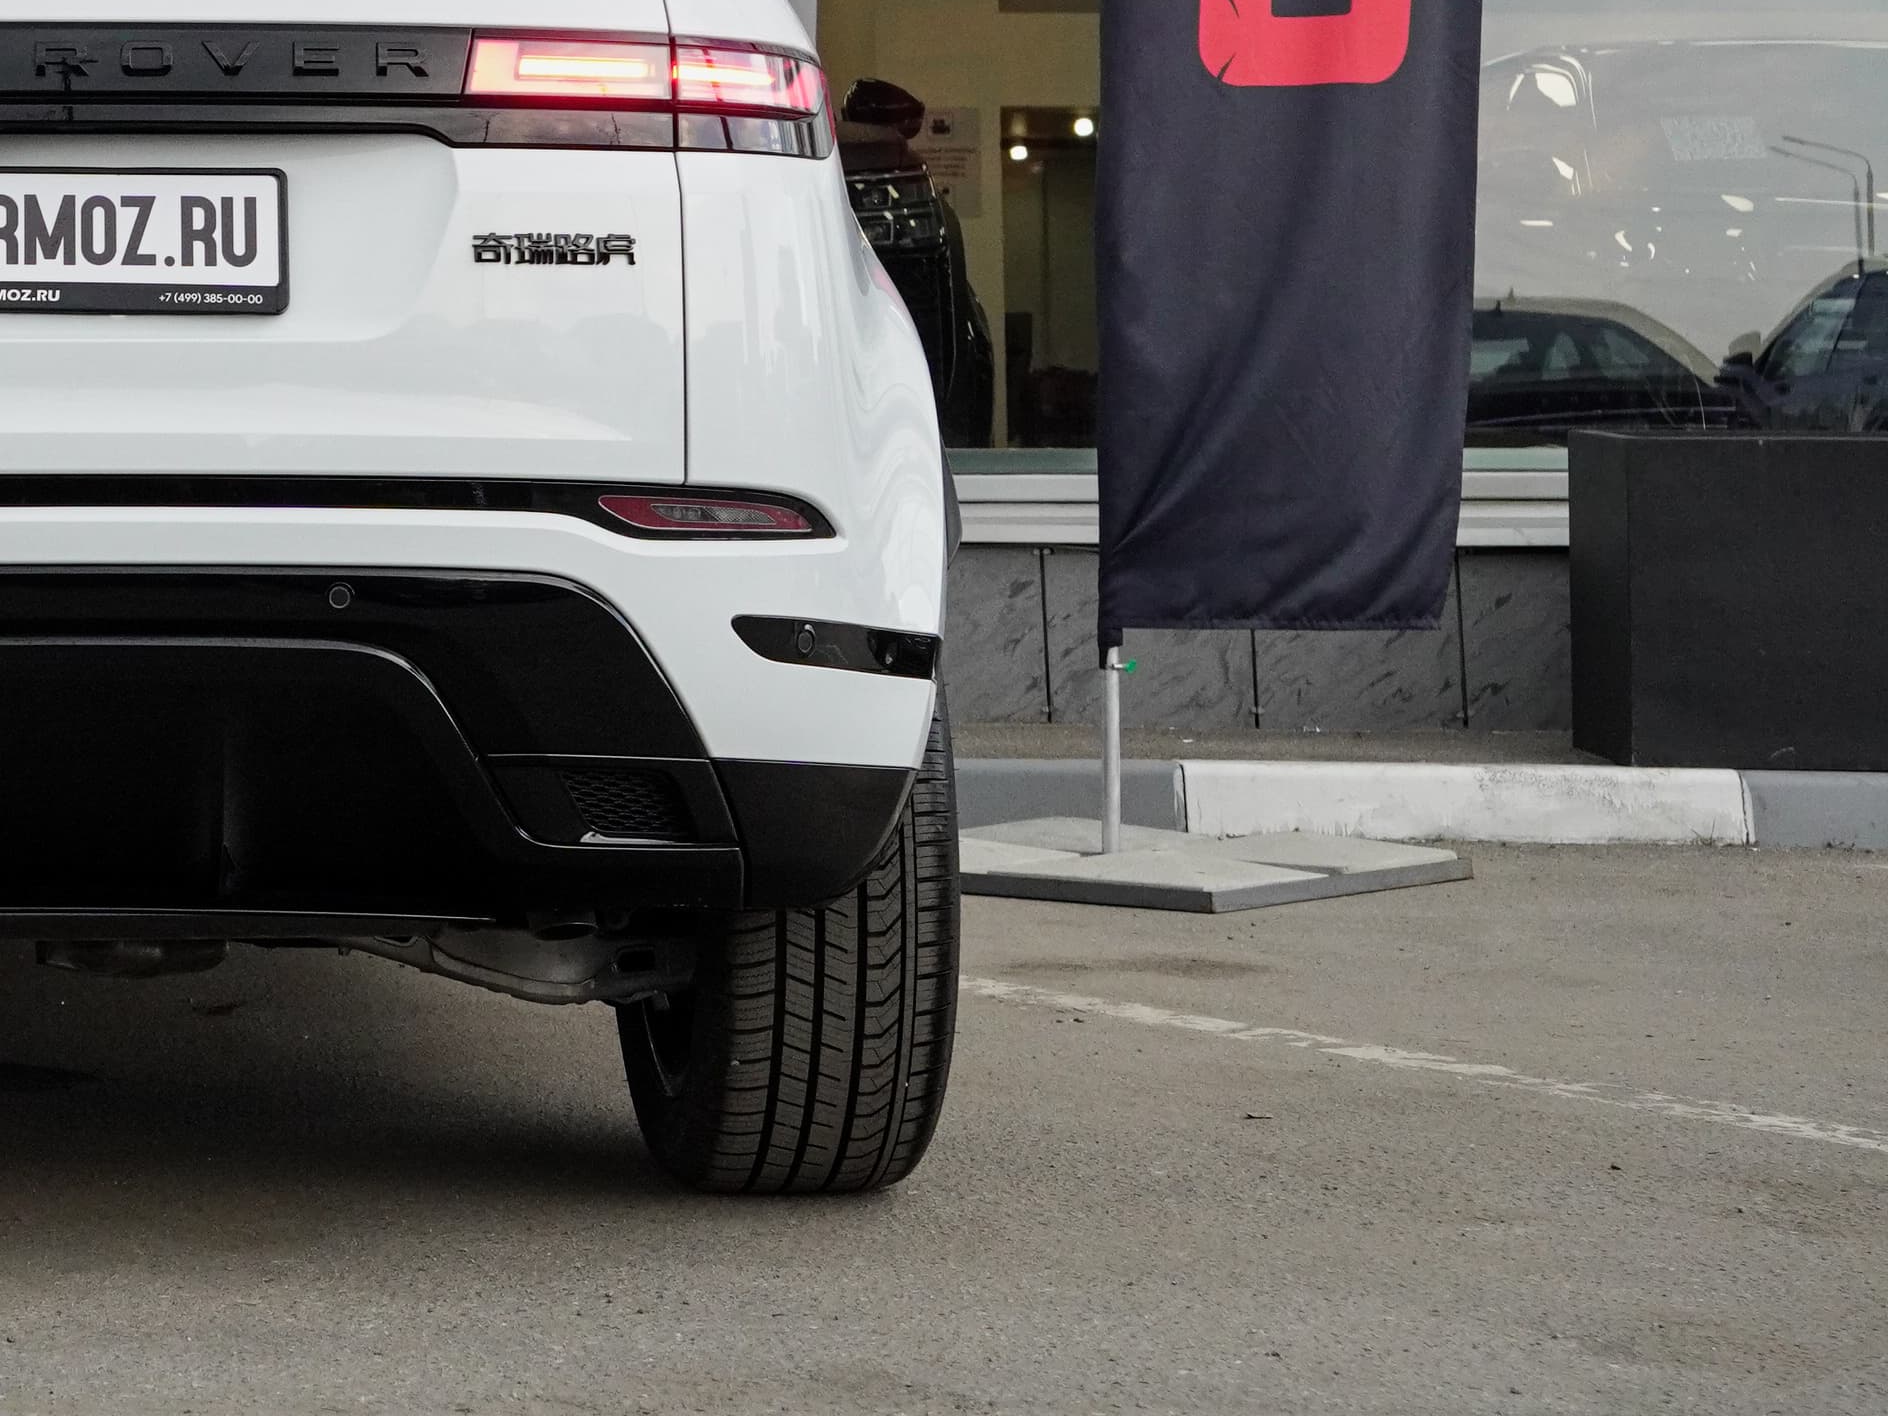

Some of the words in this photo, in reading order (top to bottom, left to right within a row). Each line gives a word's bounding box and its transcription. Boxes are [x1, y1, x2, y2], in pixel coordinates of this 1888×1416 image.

[34, 40, 431, 78] ROVER
[472, 232, 636, 265] 奇瑞路虎
[174, 292, 202, 304] (499)
[203, 293, 264, 304] 385-00-00
